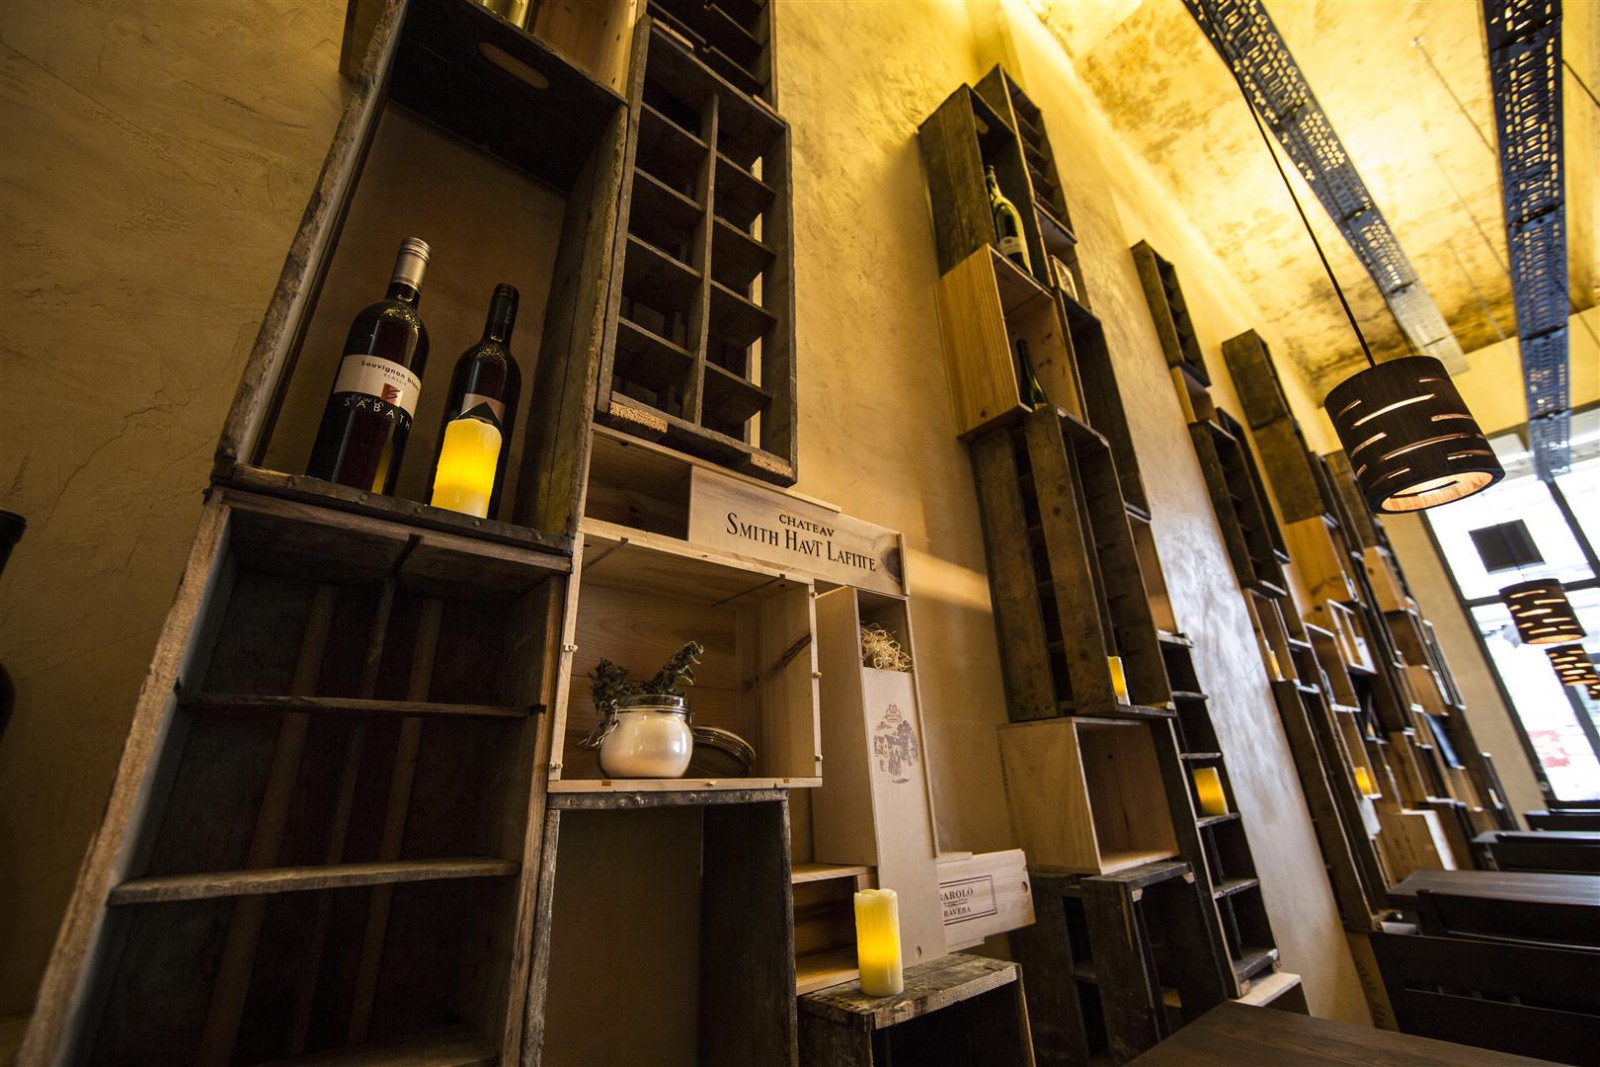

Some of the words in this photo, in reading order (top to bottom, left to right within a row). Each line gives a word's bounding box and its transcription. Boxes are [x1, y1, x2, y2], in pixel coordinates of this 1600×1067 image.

[726, 512, 779, 547] SMITH
[785, 528, 824, 557] HAVT
[827, 540, 877, 572] LAFITTE
[778, 514, 835, 537] CHATEAV
